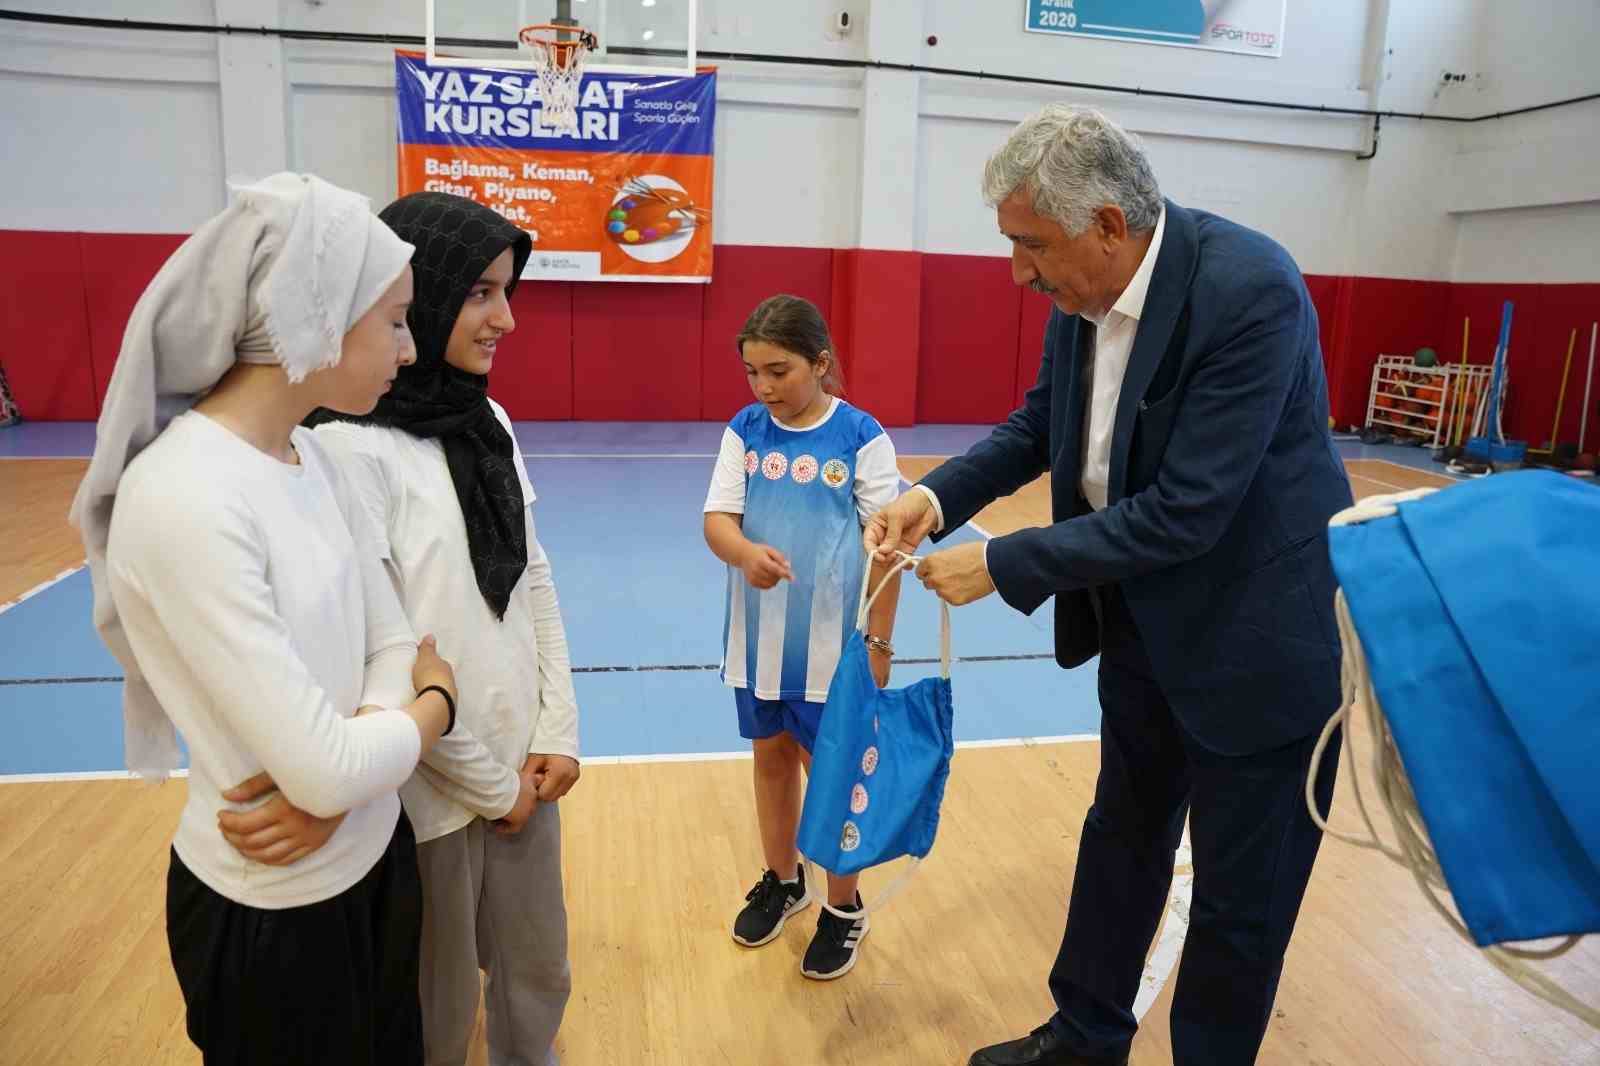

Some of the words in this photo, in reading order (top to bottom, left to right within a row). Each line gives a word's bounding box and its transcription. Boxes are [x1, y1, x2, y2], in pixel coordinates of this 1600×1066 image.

[1039, 10, 1077, 29] 2020
[417, 70, 494, 104] YAZ
[499, 76, 629, 110] SAAT
[424, 157, 516, 181] Bağlama,
[522, 162, 595, 185] Keman,
[423, 179, 478, 201] Gitar,
[484, 182, 558, 204] Piyano,
